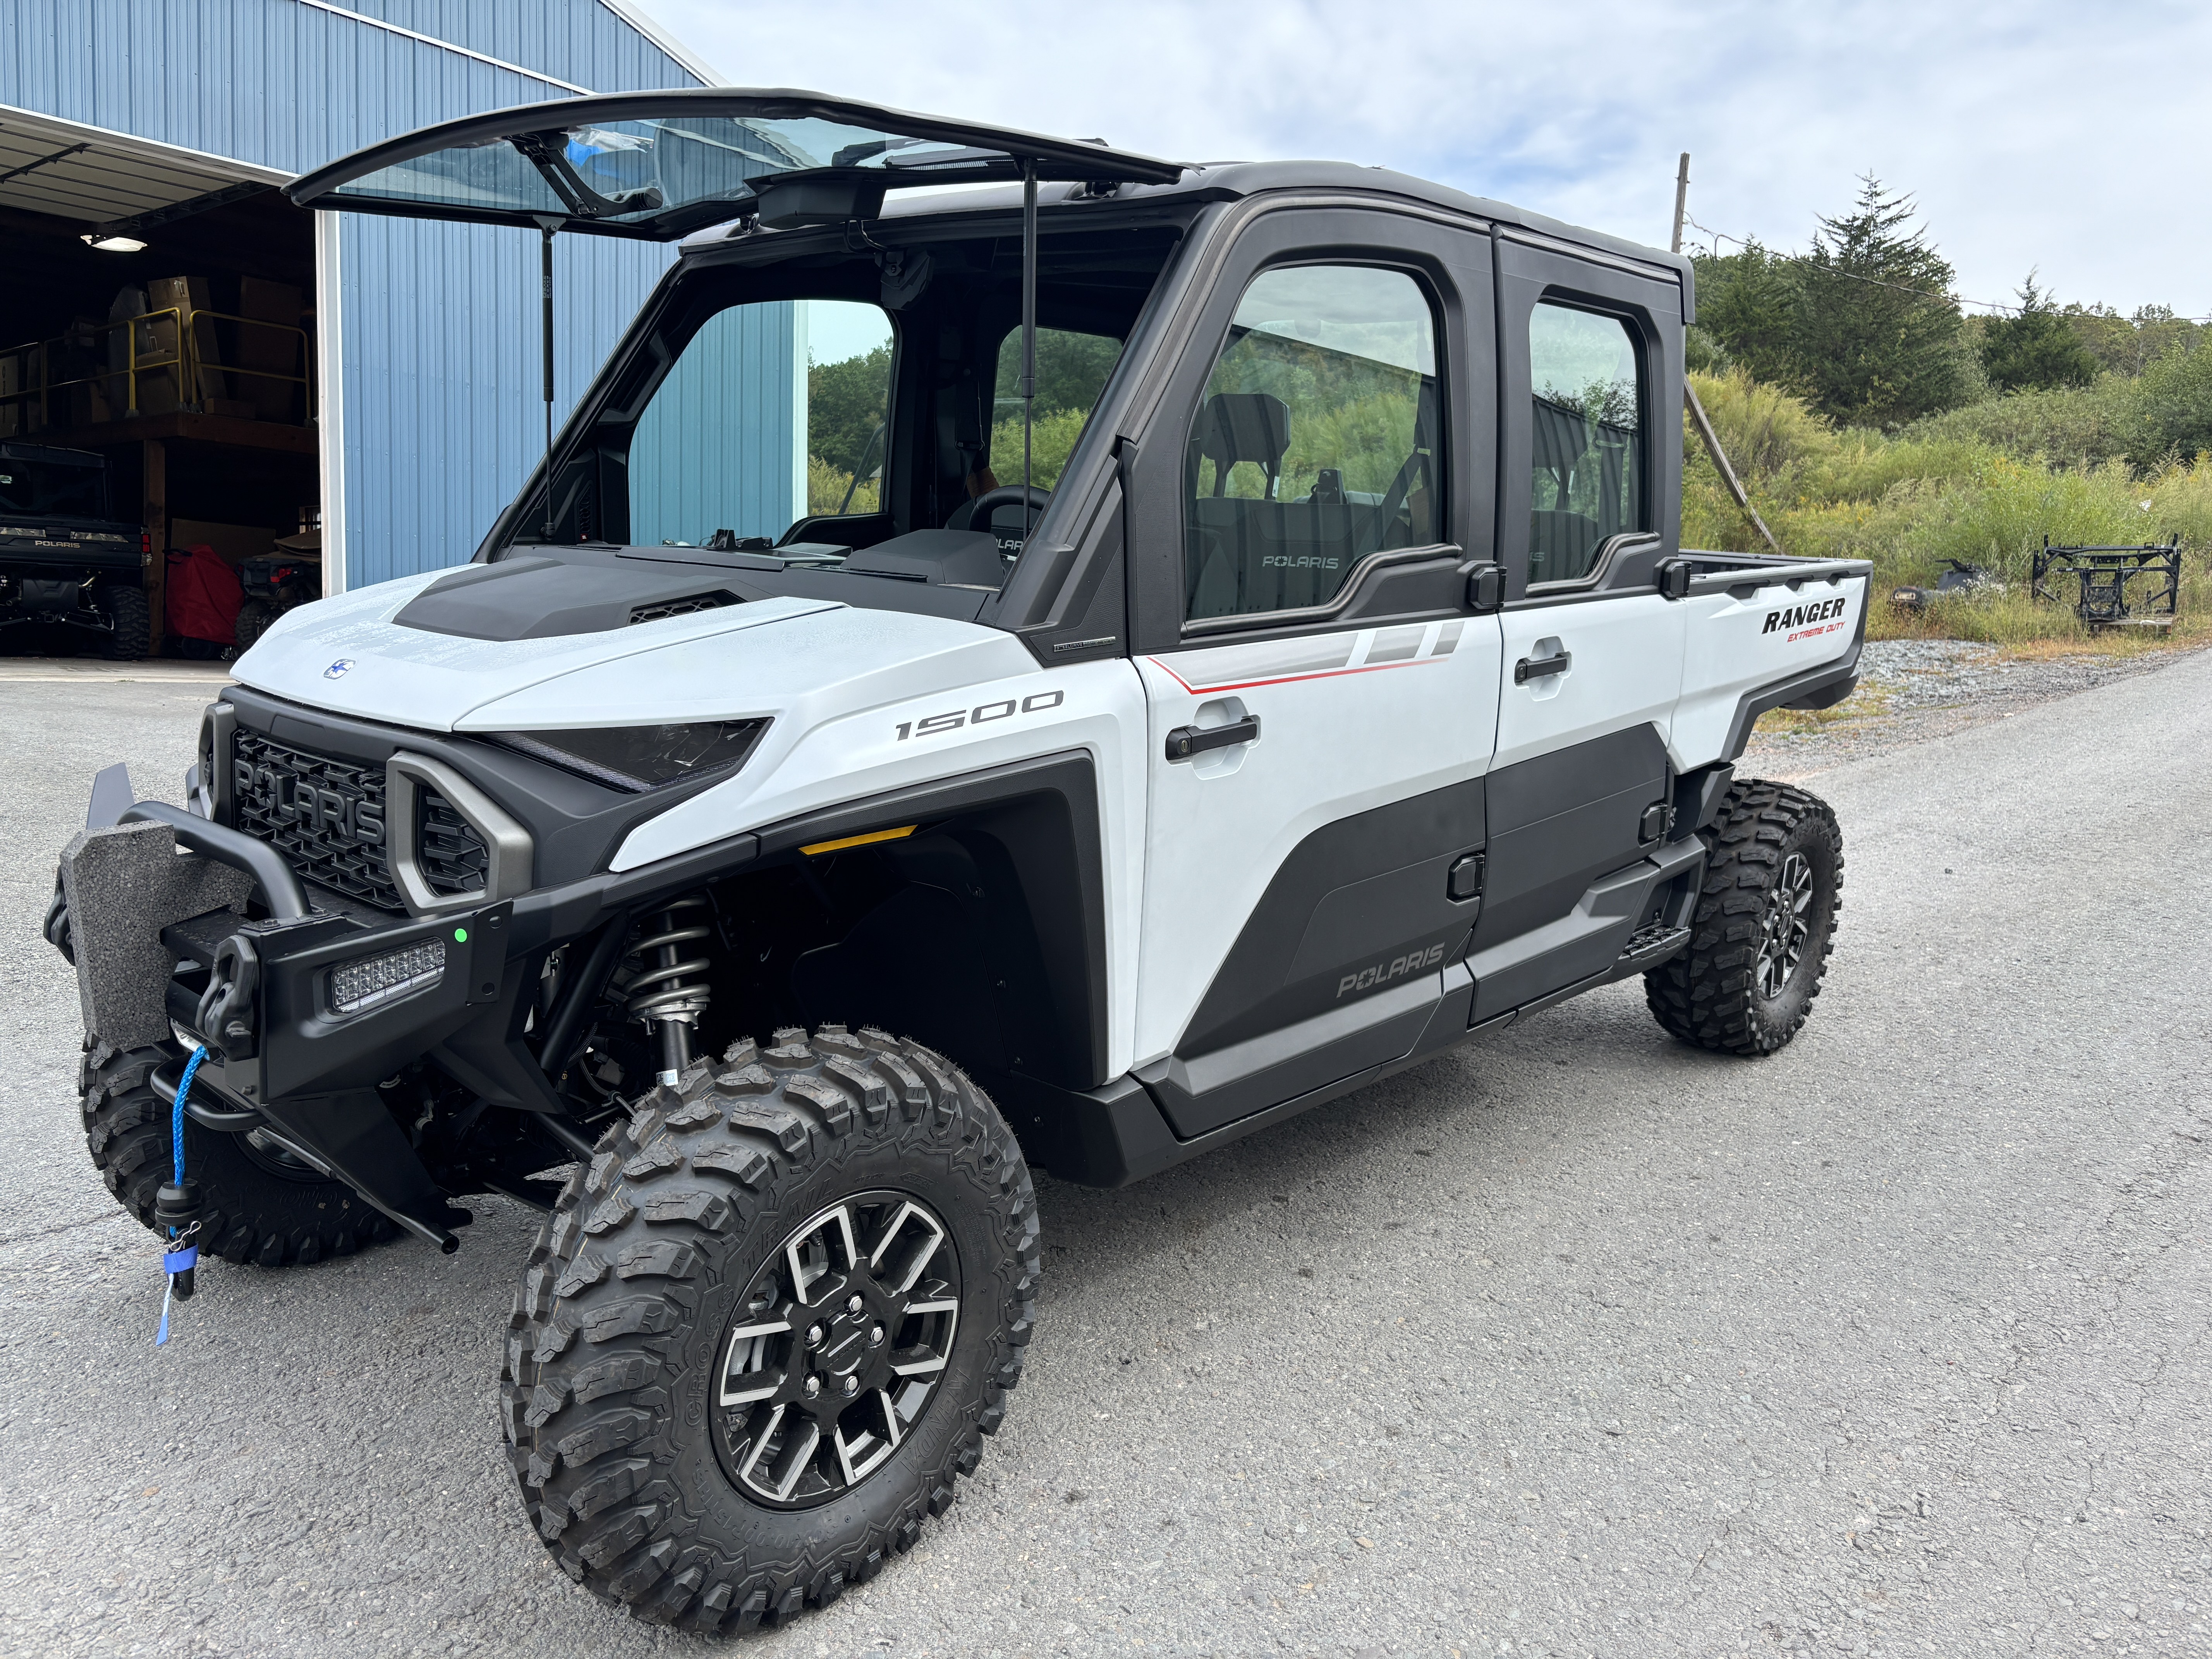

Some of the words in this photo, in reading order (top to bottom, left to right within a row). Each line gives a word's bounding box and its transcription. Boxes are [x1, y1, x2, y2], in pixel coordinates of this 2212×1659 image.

[1262, 555, 1339, 569] POLARIS
[1762, 598, 1845, 634] RANGER
[1787, 626, 1824, 643] EXTREME
[1826, 621, 1846, 633] DUTY
[895, 690, 1064, 741] 1500
[235, 758, 385, 846] POLARIS
[1336, 942, 1445, 998] POLARIS
[685, 1285, 733, 1428] CROSS
[742, 1177, 834, 1272] TRAIL
[900, 1368, 970, 1475] KENDA
